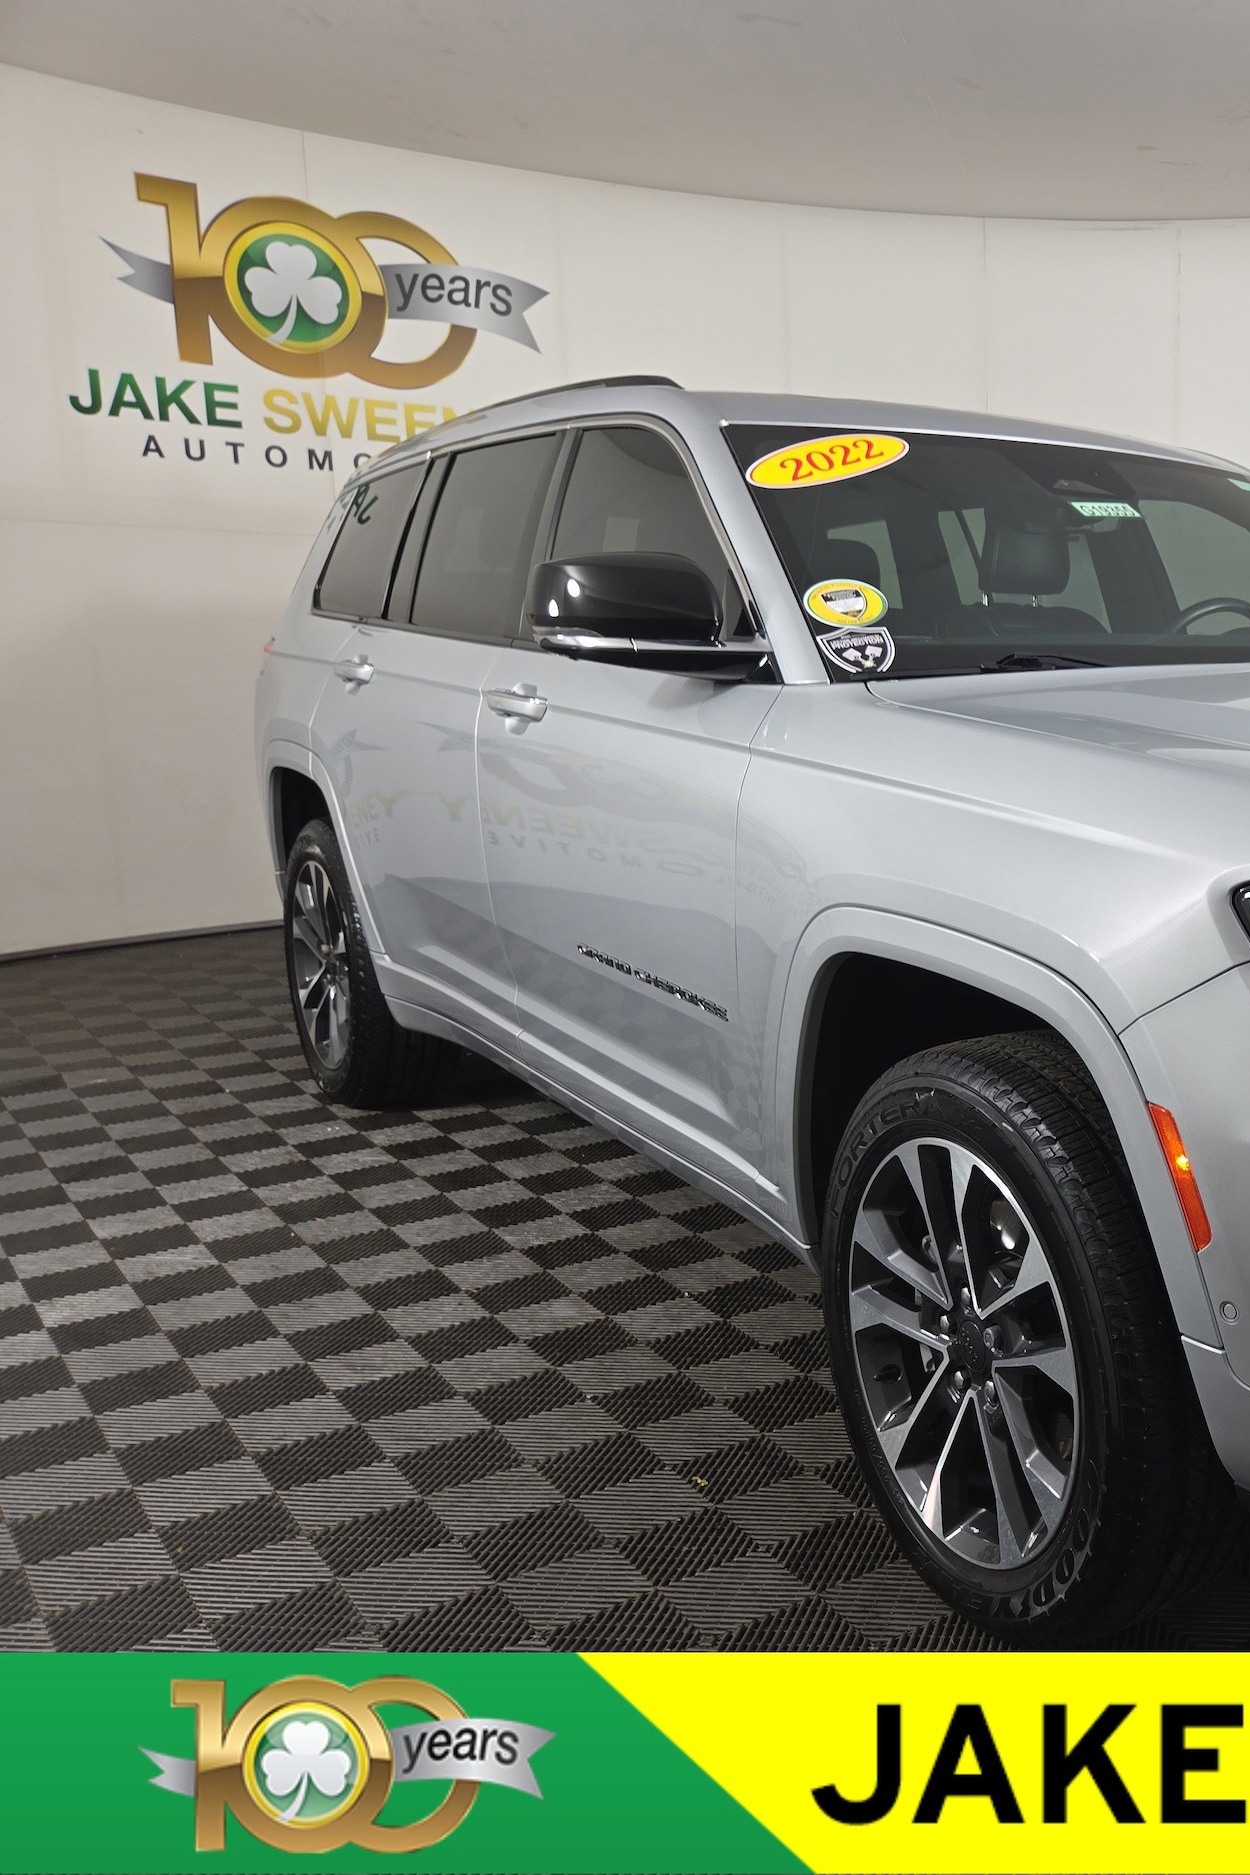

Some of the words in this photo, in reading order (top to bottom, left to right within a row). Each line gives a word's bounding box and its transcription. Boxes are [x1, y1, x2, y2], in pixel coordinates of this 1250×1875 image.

[394, 267, 514, 318] years
[69, 368, 243, 429] JAKE
[779, 439, 885, 482] 2022
[576, 941, 632, 976] GRAND
[633, 967, 729, 1022] CHEROKEE
[831, 1096, 946, 1220] FORTERA
